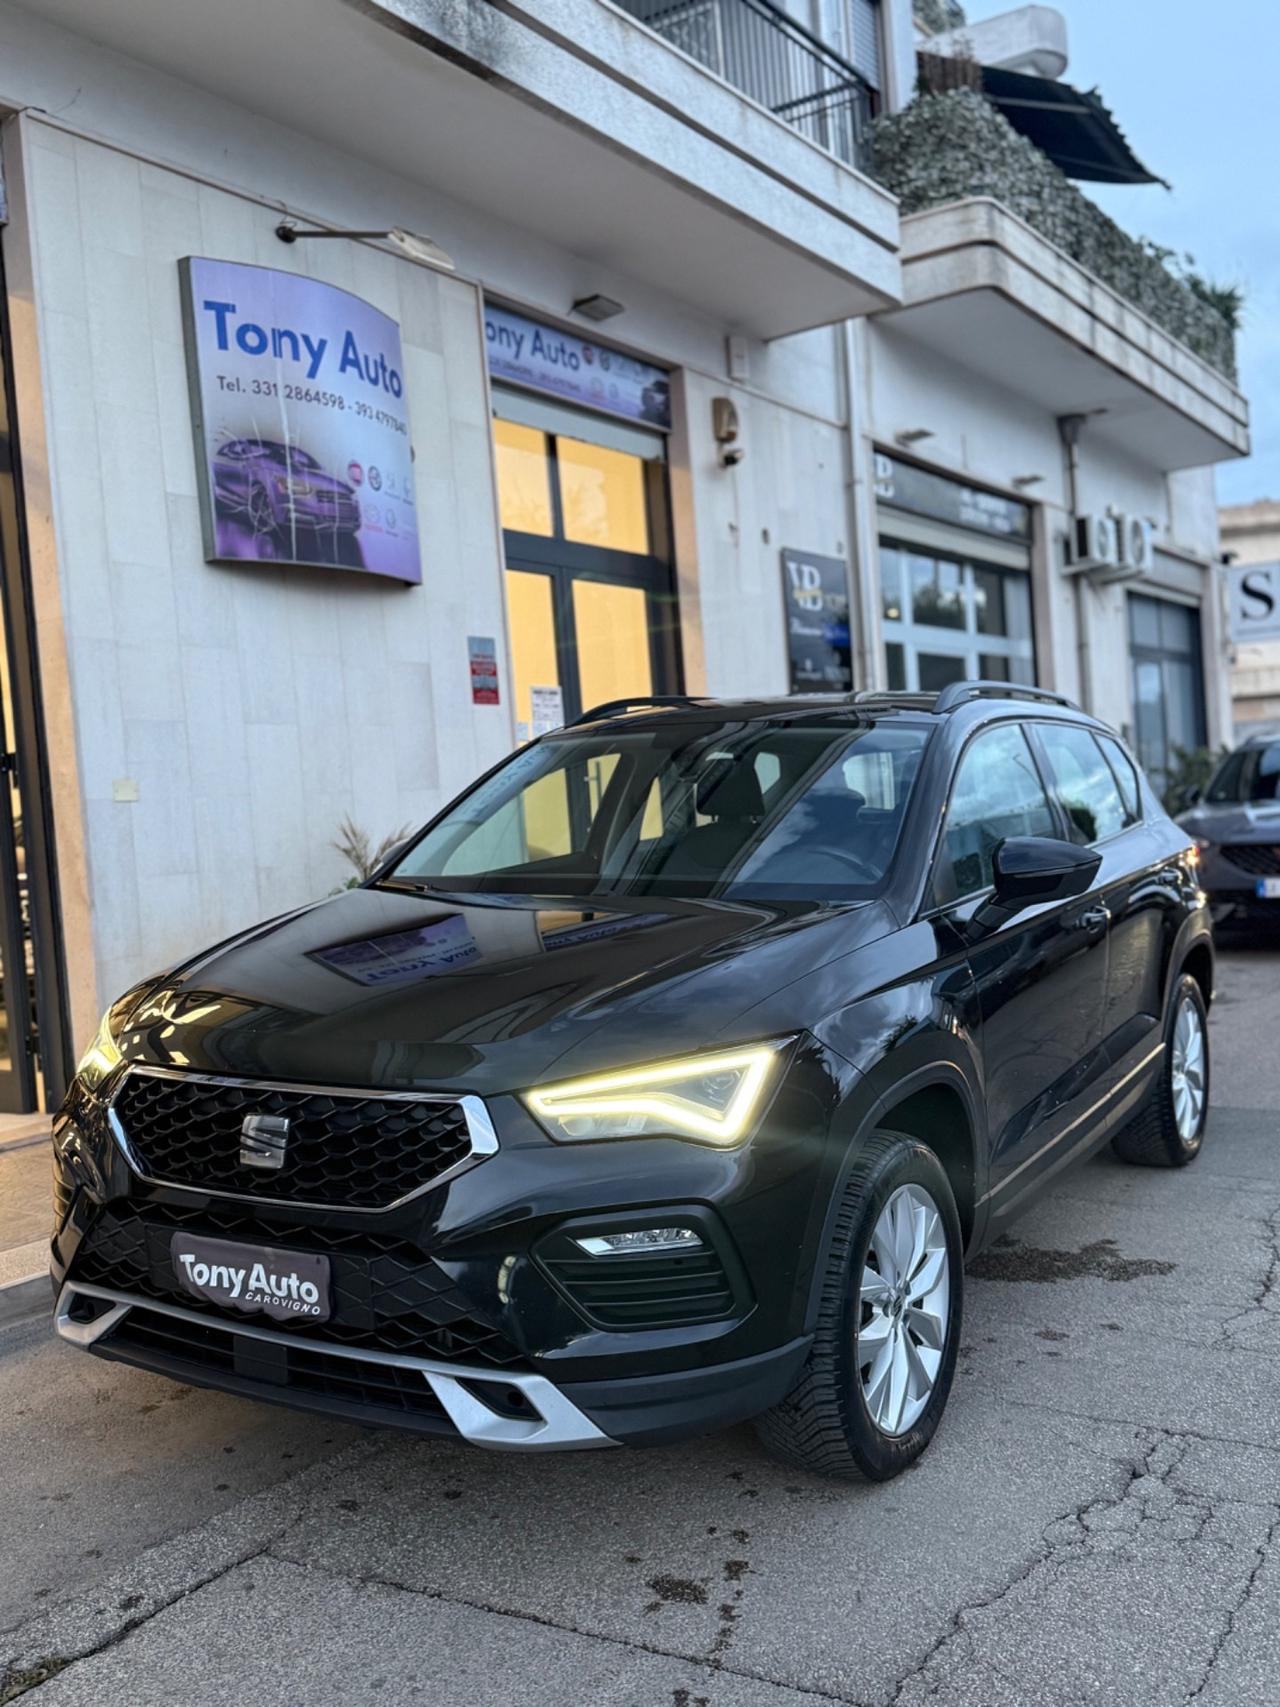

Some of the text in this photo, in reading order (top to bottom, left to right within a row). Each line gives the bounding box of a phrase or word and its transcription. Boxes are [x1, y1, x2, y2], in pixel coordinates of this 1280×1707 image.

[203, 299, 328, 380] Tony
[338, 330, 402, 399] Auto
[485, 320, 580, 371] ony Auto
[216, 375, 246, 393] Tel.
[252, 379, 278, 397] 331
[283, 384, 345, 410] 2864598
[1239, 570, 1275, 622] S
[179, 1253, 319, 1304] Tony Auto
[244, 1291, 321, 1316] CAROVIGNO
